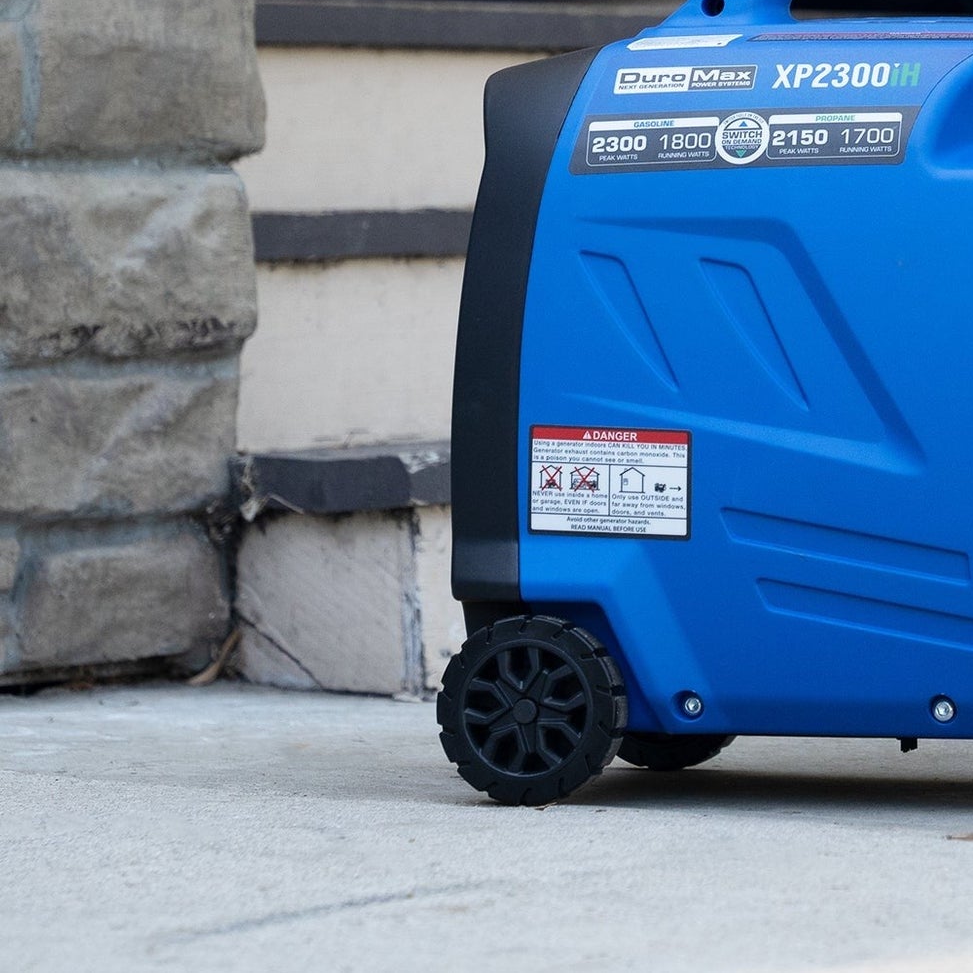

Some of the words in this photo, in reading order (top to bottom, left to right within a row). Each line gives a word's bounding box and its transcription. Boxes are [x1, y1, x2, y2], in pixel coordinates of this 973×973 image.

[772, 62, 922, 89] XP2300iH
[633, 120, 675, 128] GASOLINE
[722, 131, 763, 139] SWITCH
[772, 129, 829, 146] 2150
[841, 128, 895, 144] 1700
[592, 135, 647, 153] 2300
[660, 132, 712, 150] 1800
[592, 431, 638, 441] DANGER
[599, 517, 627, 525] generator
